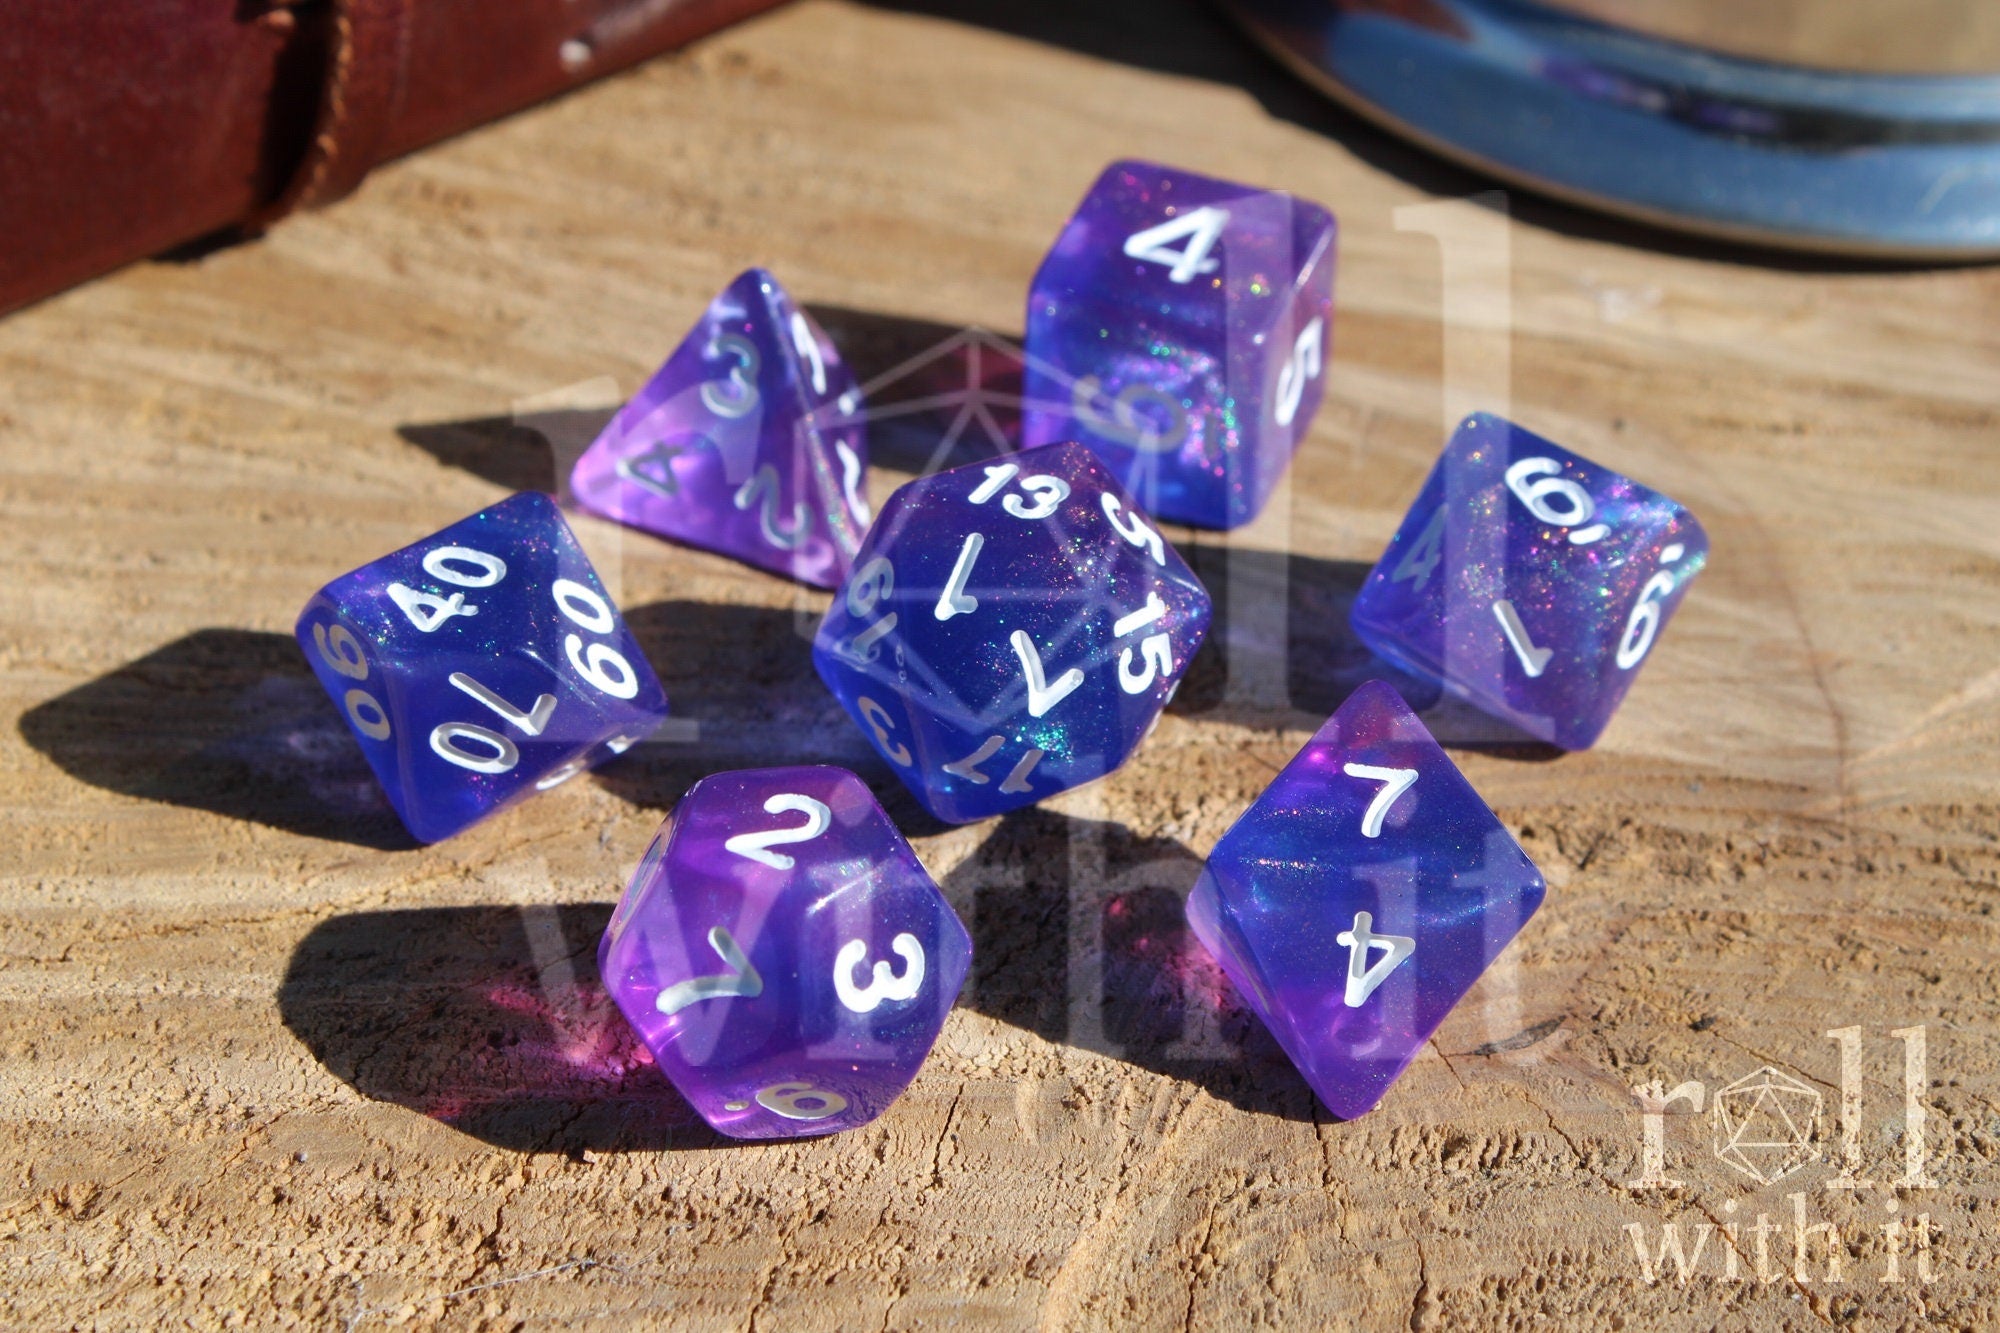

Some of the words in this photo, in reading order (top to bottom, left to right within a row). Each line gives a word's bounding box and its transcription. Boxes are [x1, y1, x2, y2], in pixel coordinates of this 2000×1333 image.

[1123, 206, 1231, 284] 4
[701, 333, 760, 418] 3
[1274, 316, 1323, 427] 5
[734, 463, 812, 550] 2
[968, 463, 1071, 520] 13
[1101, 492, 1166, 566] 5
[386, 546, 507, 633] 40
[934, 532, 985, 621] 1
[1392, 501, 1449, 593] 4
[552, 578, 639, 699] 60
[1113, 591, 1174, 695] 15
[429, 672, 558, 774] 70
[857, 696, 912, 768] 3
[725, 793, 831, 870] 2
[1343, 762, 1419, 838] 7
[656, 926, 763, 1016] 7
[833, 933, 925, 1013] 3
[1336, 911, 1416, 1008] 4
